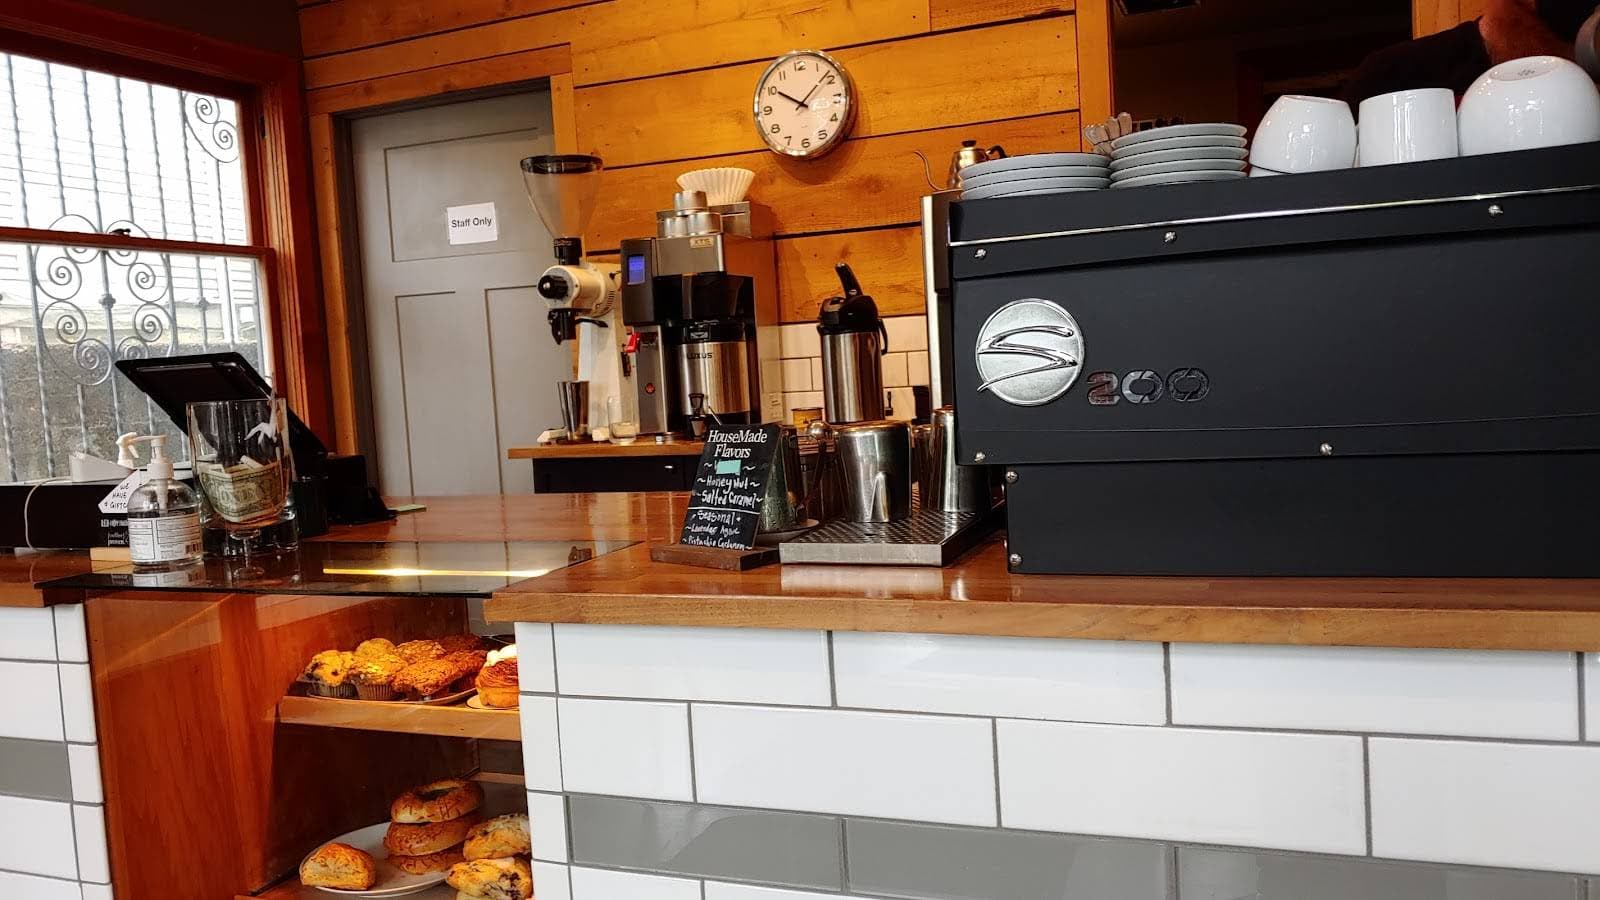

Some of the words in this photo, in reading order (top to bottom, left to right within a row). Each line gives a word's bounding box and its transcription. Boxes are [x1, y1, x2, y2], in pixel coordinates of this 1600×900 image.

[794, 61, 806, 72] 12
[778, 70, 786, 80] 11
[826, 75, 836, 85] 2
[767, 86, 777, 96] 10
[832, 93, 842, 103] 3
[763, 106, 773, 116] 9
[829, 112, 839, 122] 4
[771, 124, 781, 134] 8
[818, 129, 828, 140] 5
[784, 136, 792, 146] 7
[801, 138, 811, 148] 6
[451, 218, 471, 228] Staff
[472, 217, 492, 227] Only
[687, 352, 713, 360] LUXUS
[1087, 367, 1210, 407] 200
[707, 428, 768, 444] HouseMade
[714, 443, 752, 459] Flavors
[706, 475, 733, 494] Honey
[733, 477, 748, 490] Nut
[701, 489, 728, 506] Salted
[728, 491, 756, 508] Caramel
[697, 509, 736, 526] Seasonal
